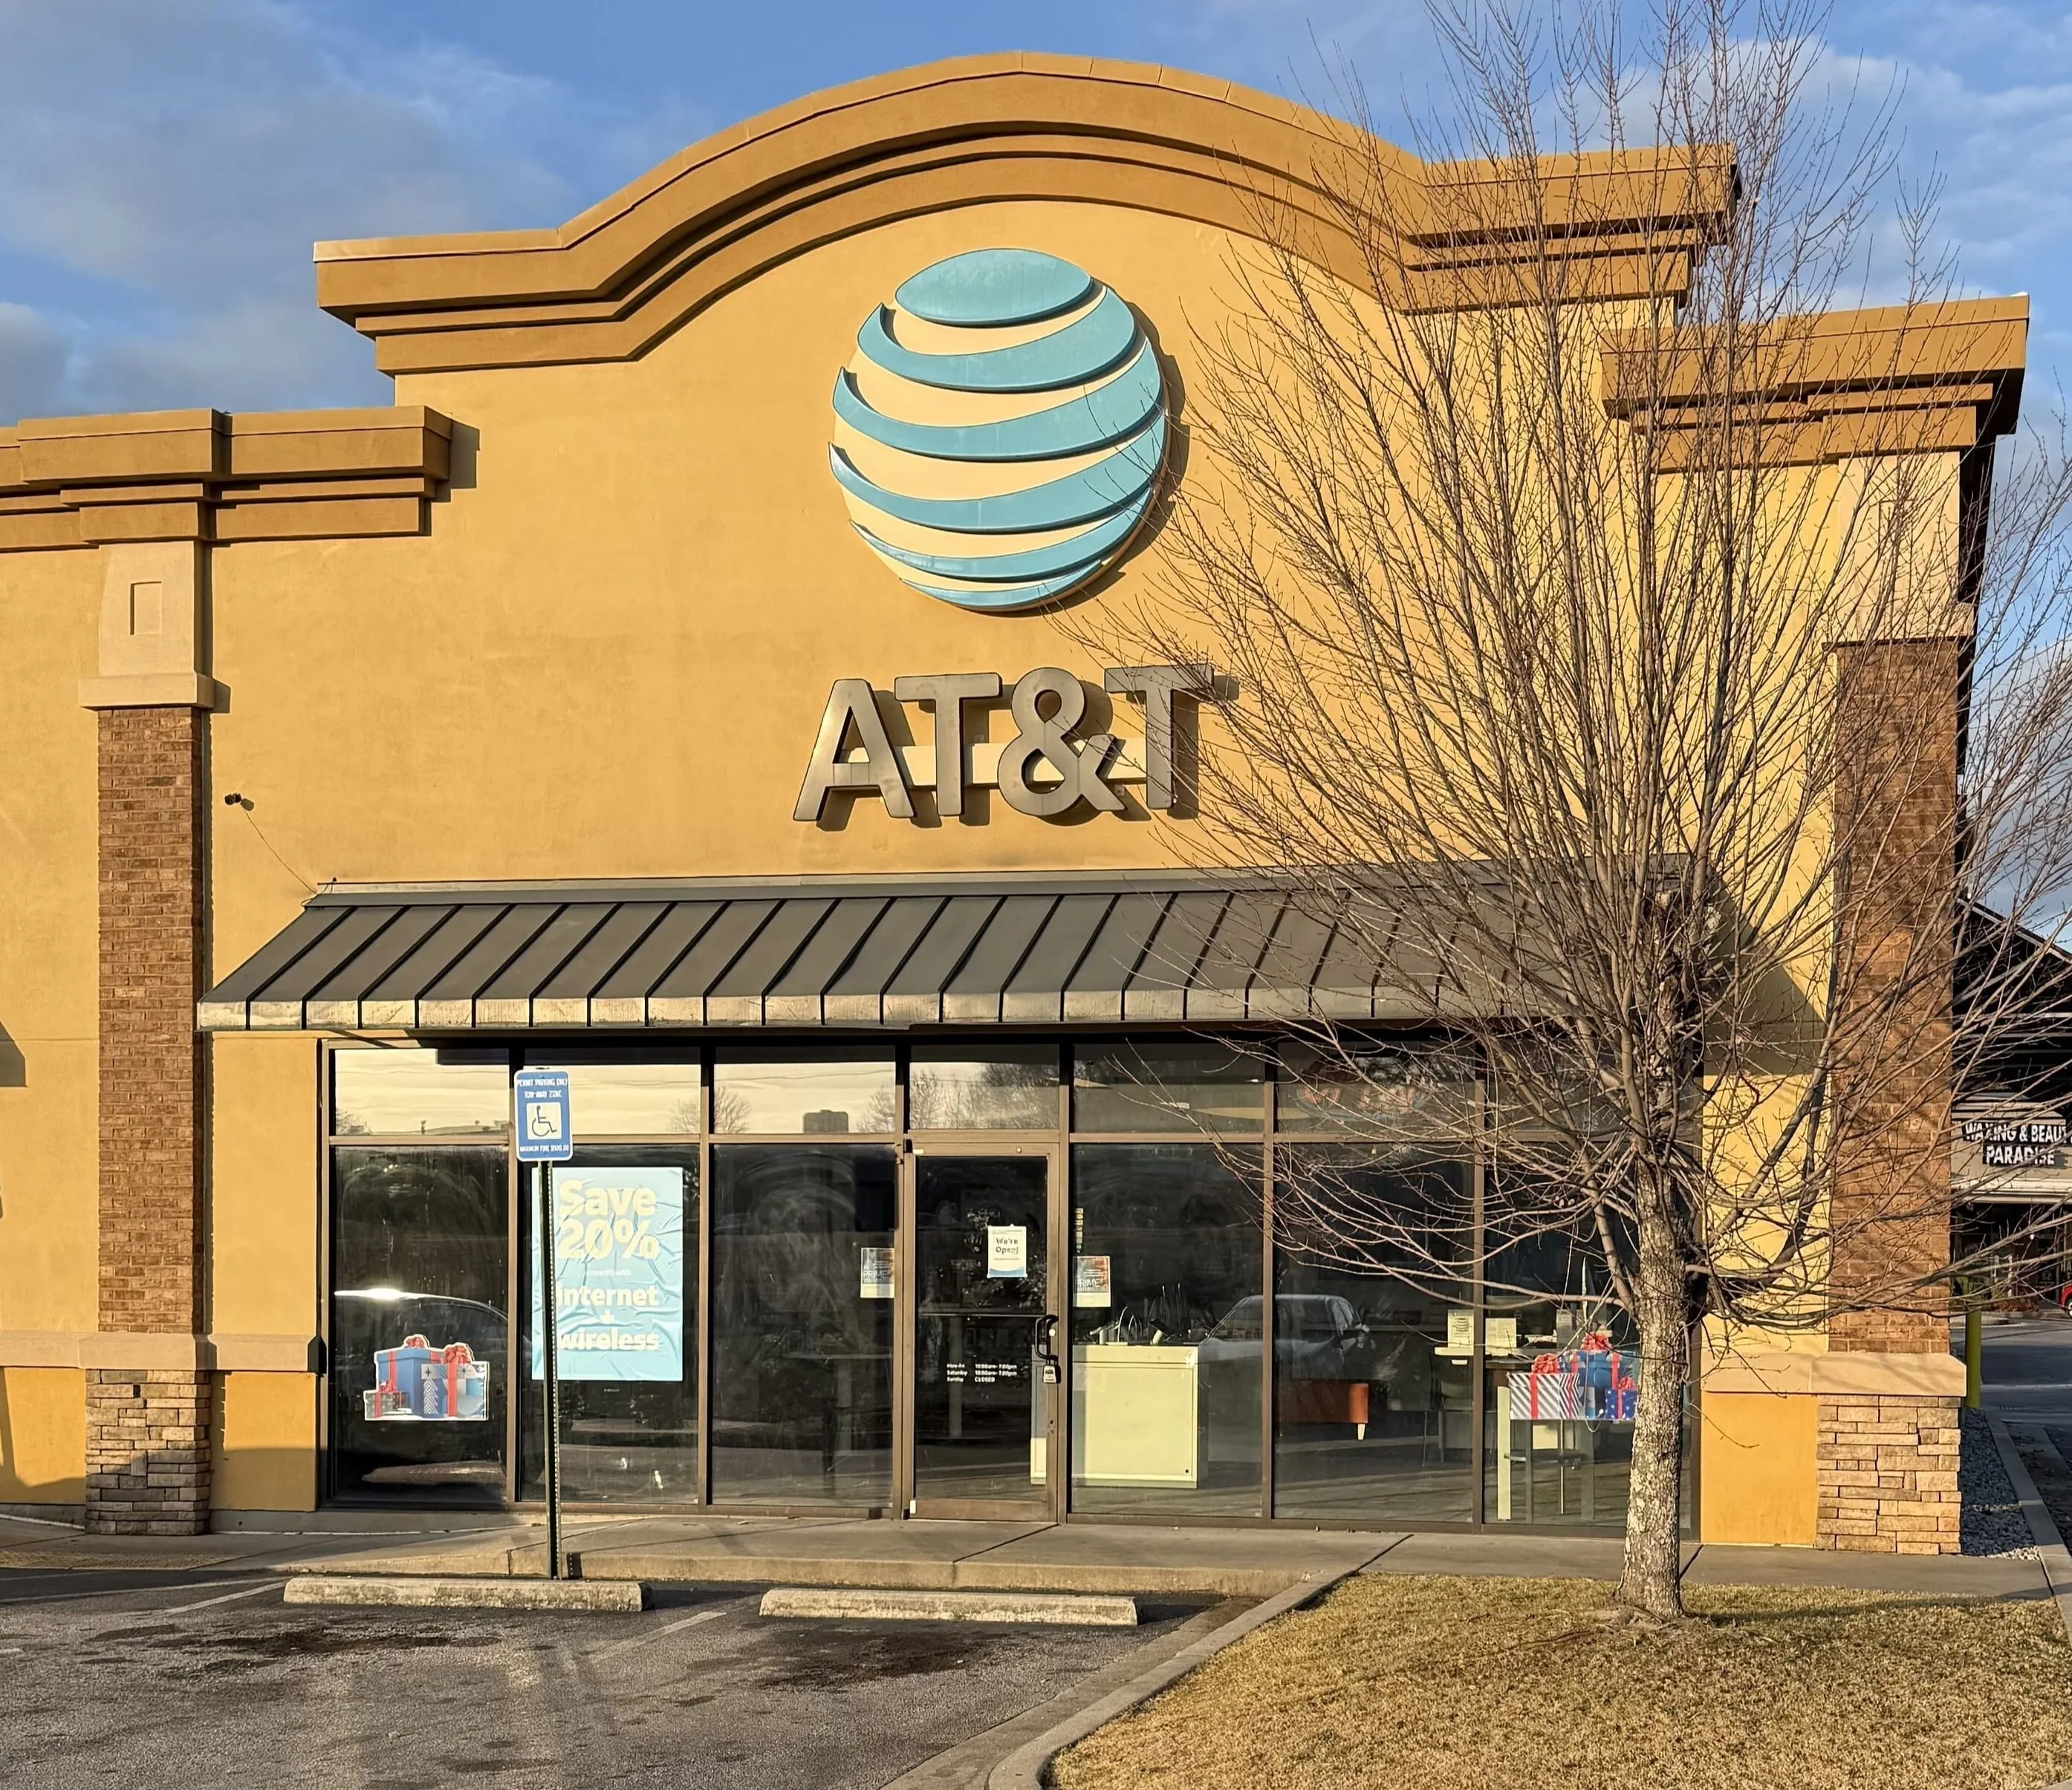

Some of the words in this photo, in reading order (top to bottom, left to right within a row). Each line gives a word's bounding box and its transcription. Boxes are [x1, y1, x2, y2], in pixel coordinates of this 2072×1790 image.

[793, 664, 1215, 821] AT&T
[2019, 1125, 2028, 1142] &
[559, 1179, 657, 1217] Save
[559, 1219, 660, 1260] 20%
[556, 1282, 659, 1306] internet
[557, 1327, 660, 1352] wireless
